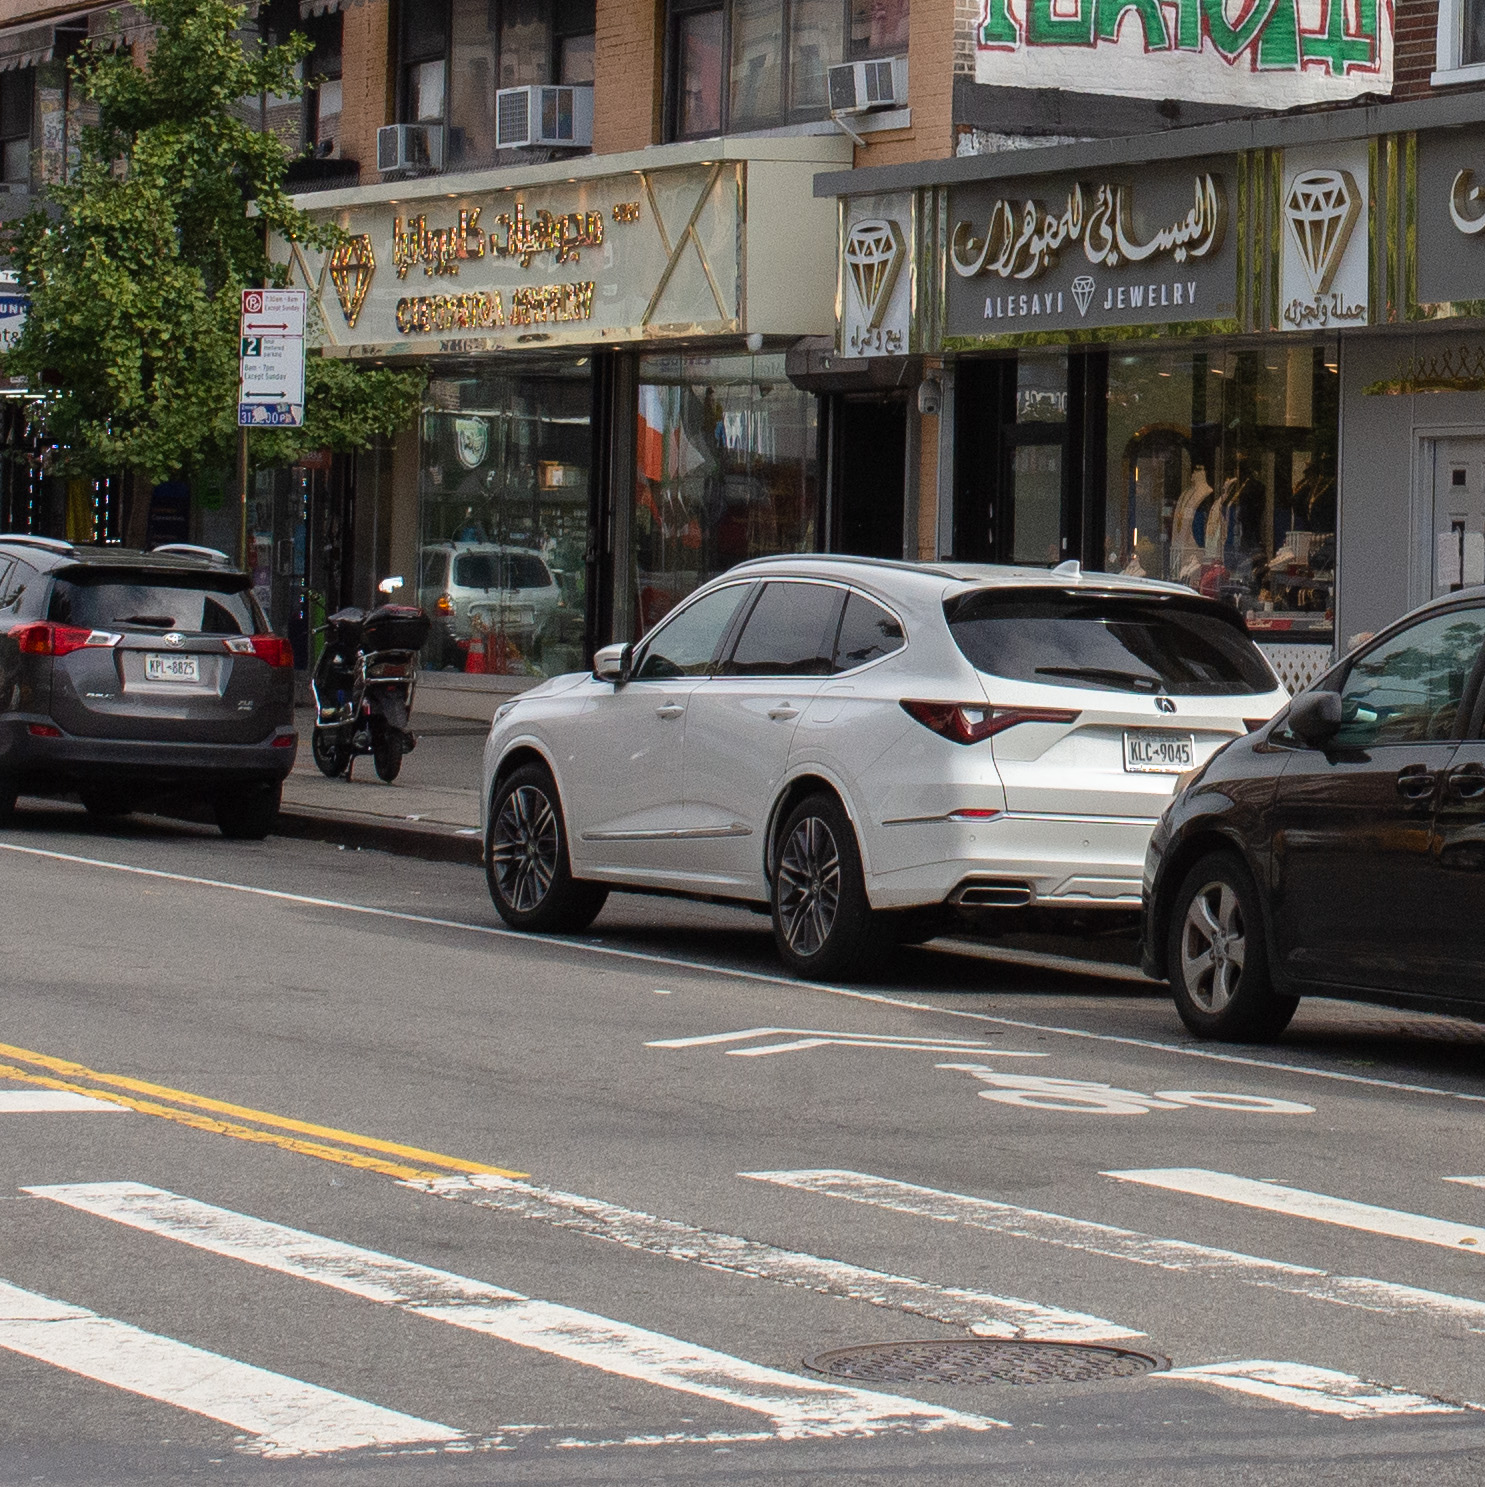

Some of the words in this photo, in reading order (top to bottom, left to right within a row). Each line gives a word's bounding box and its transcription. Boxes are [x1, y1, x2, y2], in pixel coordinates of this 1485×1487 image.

[510, 281, 596, 325] JEWELRY
[983, 291, 1063, 319] ALESAYI
[1104, 281, 1197, 309] JEWELRY
[247, 337, 256, 355] 2
[245, 364, 256, 372] 8am
[262, 364, 275, 373] 7pm
[266, 372, 287, 381] Sunday
